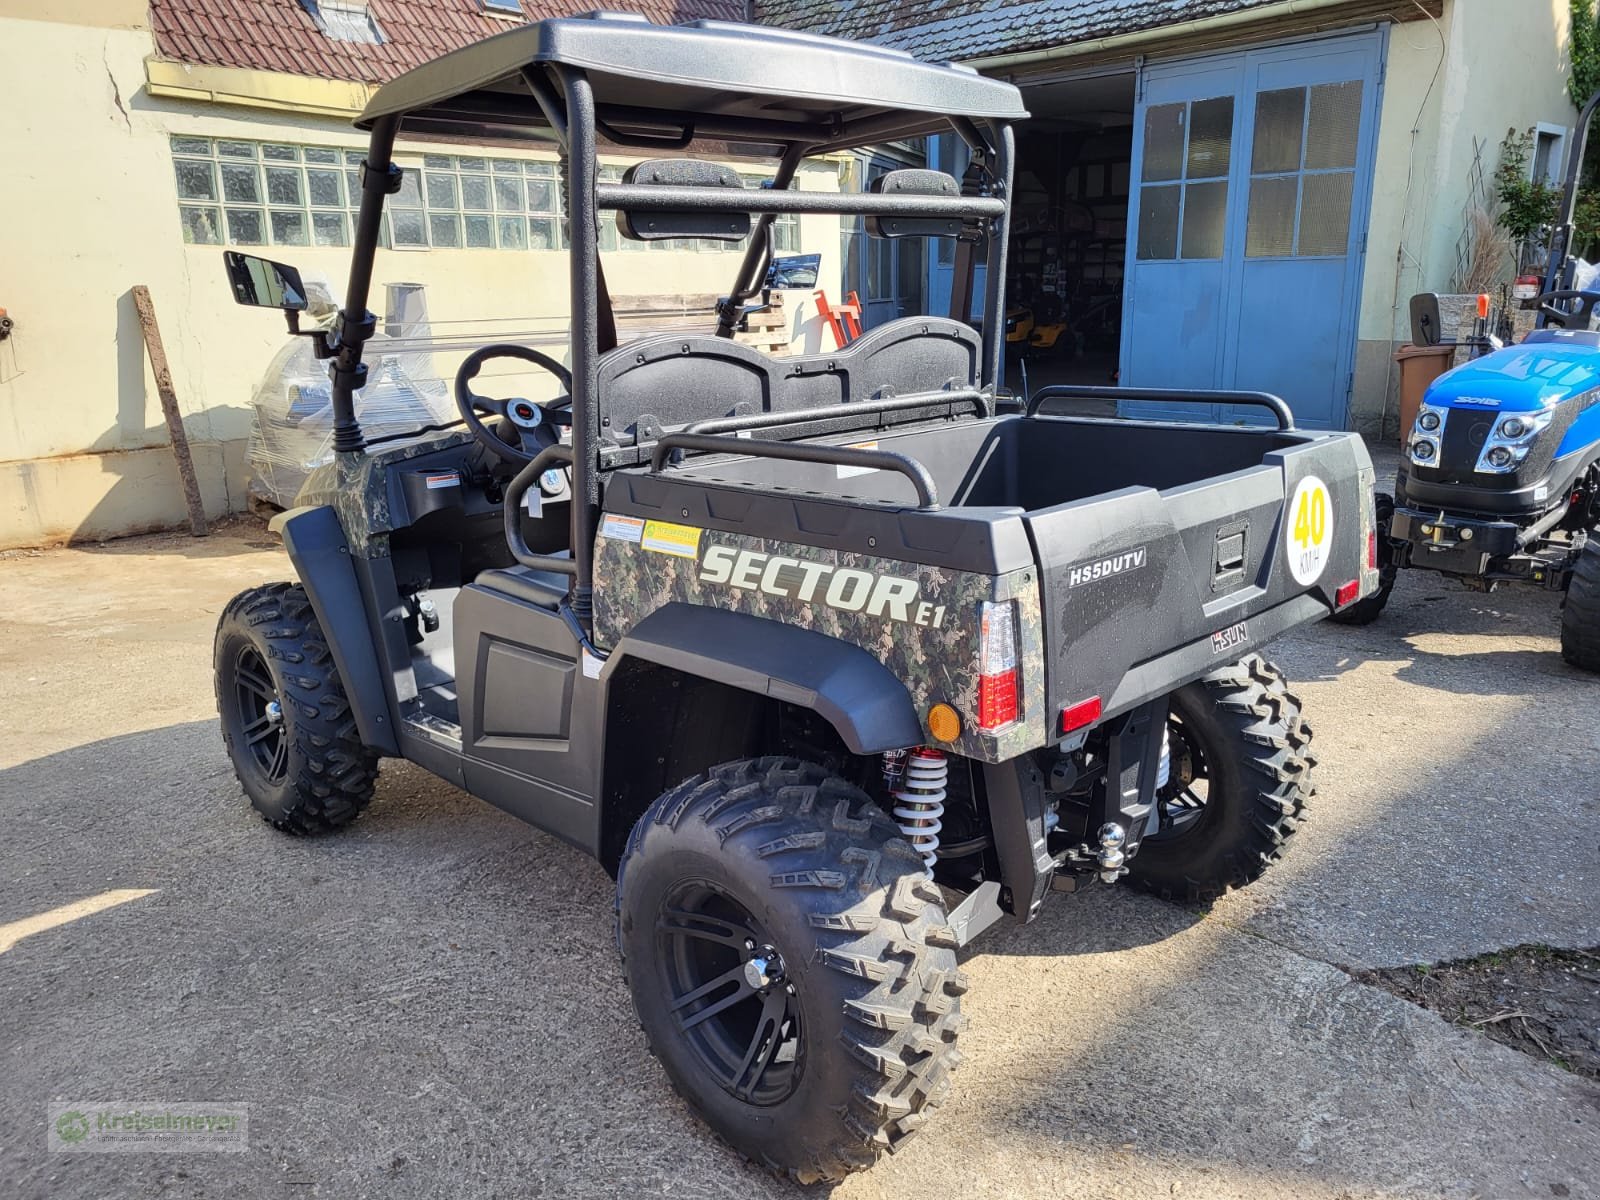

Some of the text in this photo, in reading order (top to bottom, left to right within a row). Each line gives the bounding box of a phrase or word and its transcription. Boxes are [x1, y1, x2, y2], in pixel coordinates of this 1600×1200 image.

[1294, 487, 1326, 548] 40
[700, 546, 946, 629] SECTOR E1
[1069, 549, 1145, 586] HS5DUTV
[1210, 622, 1249, 654] HSUN
